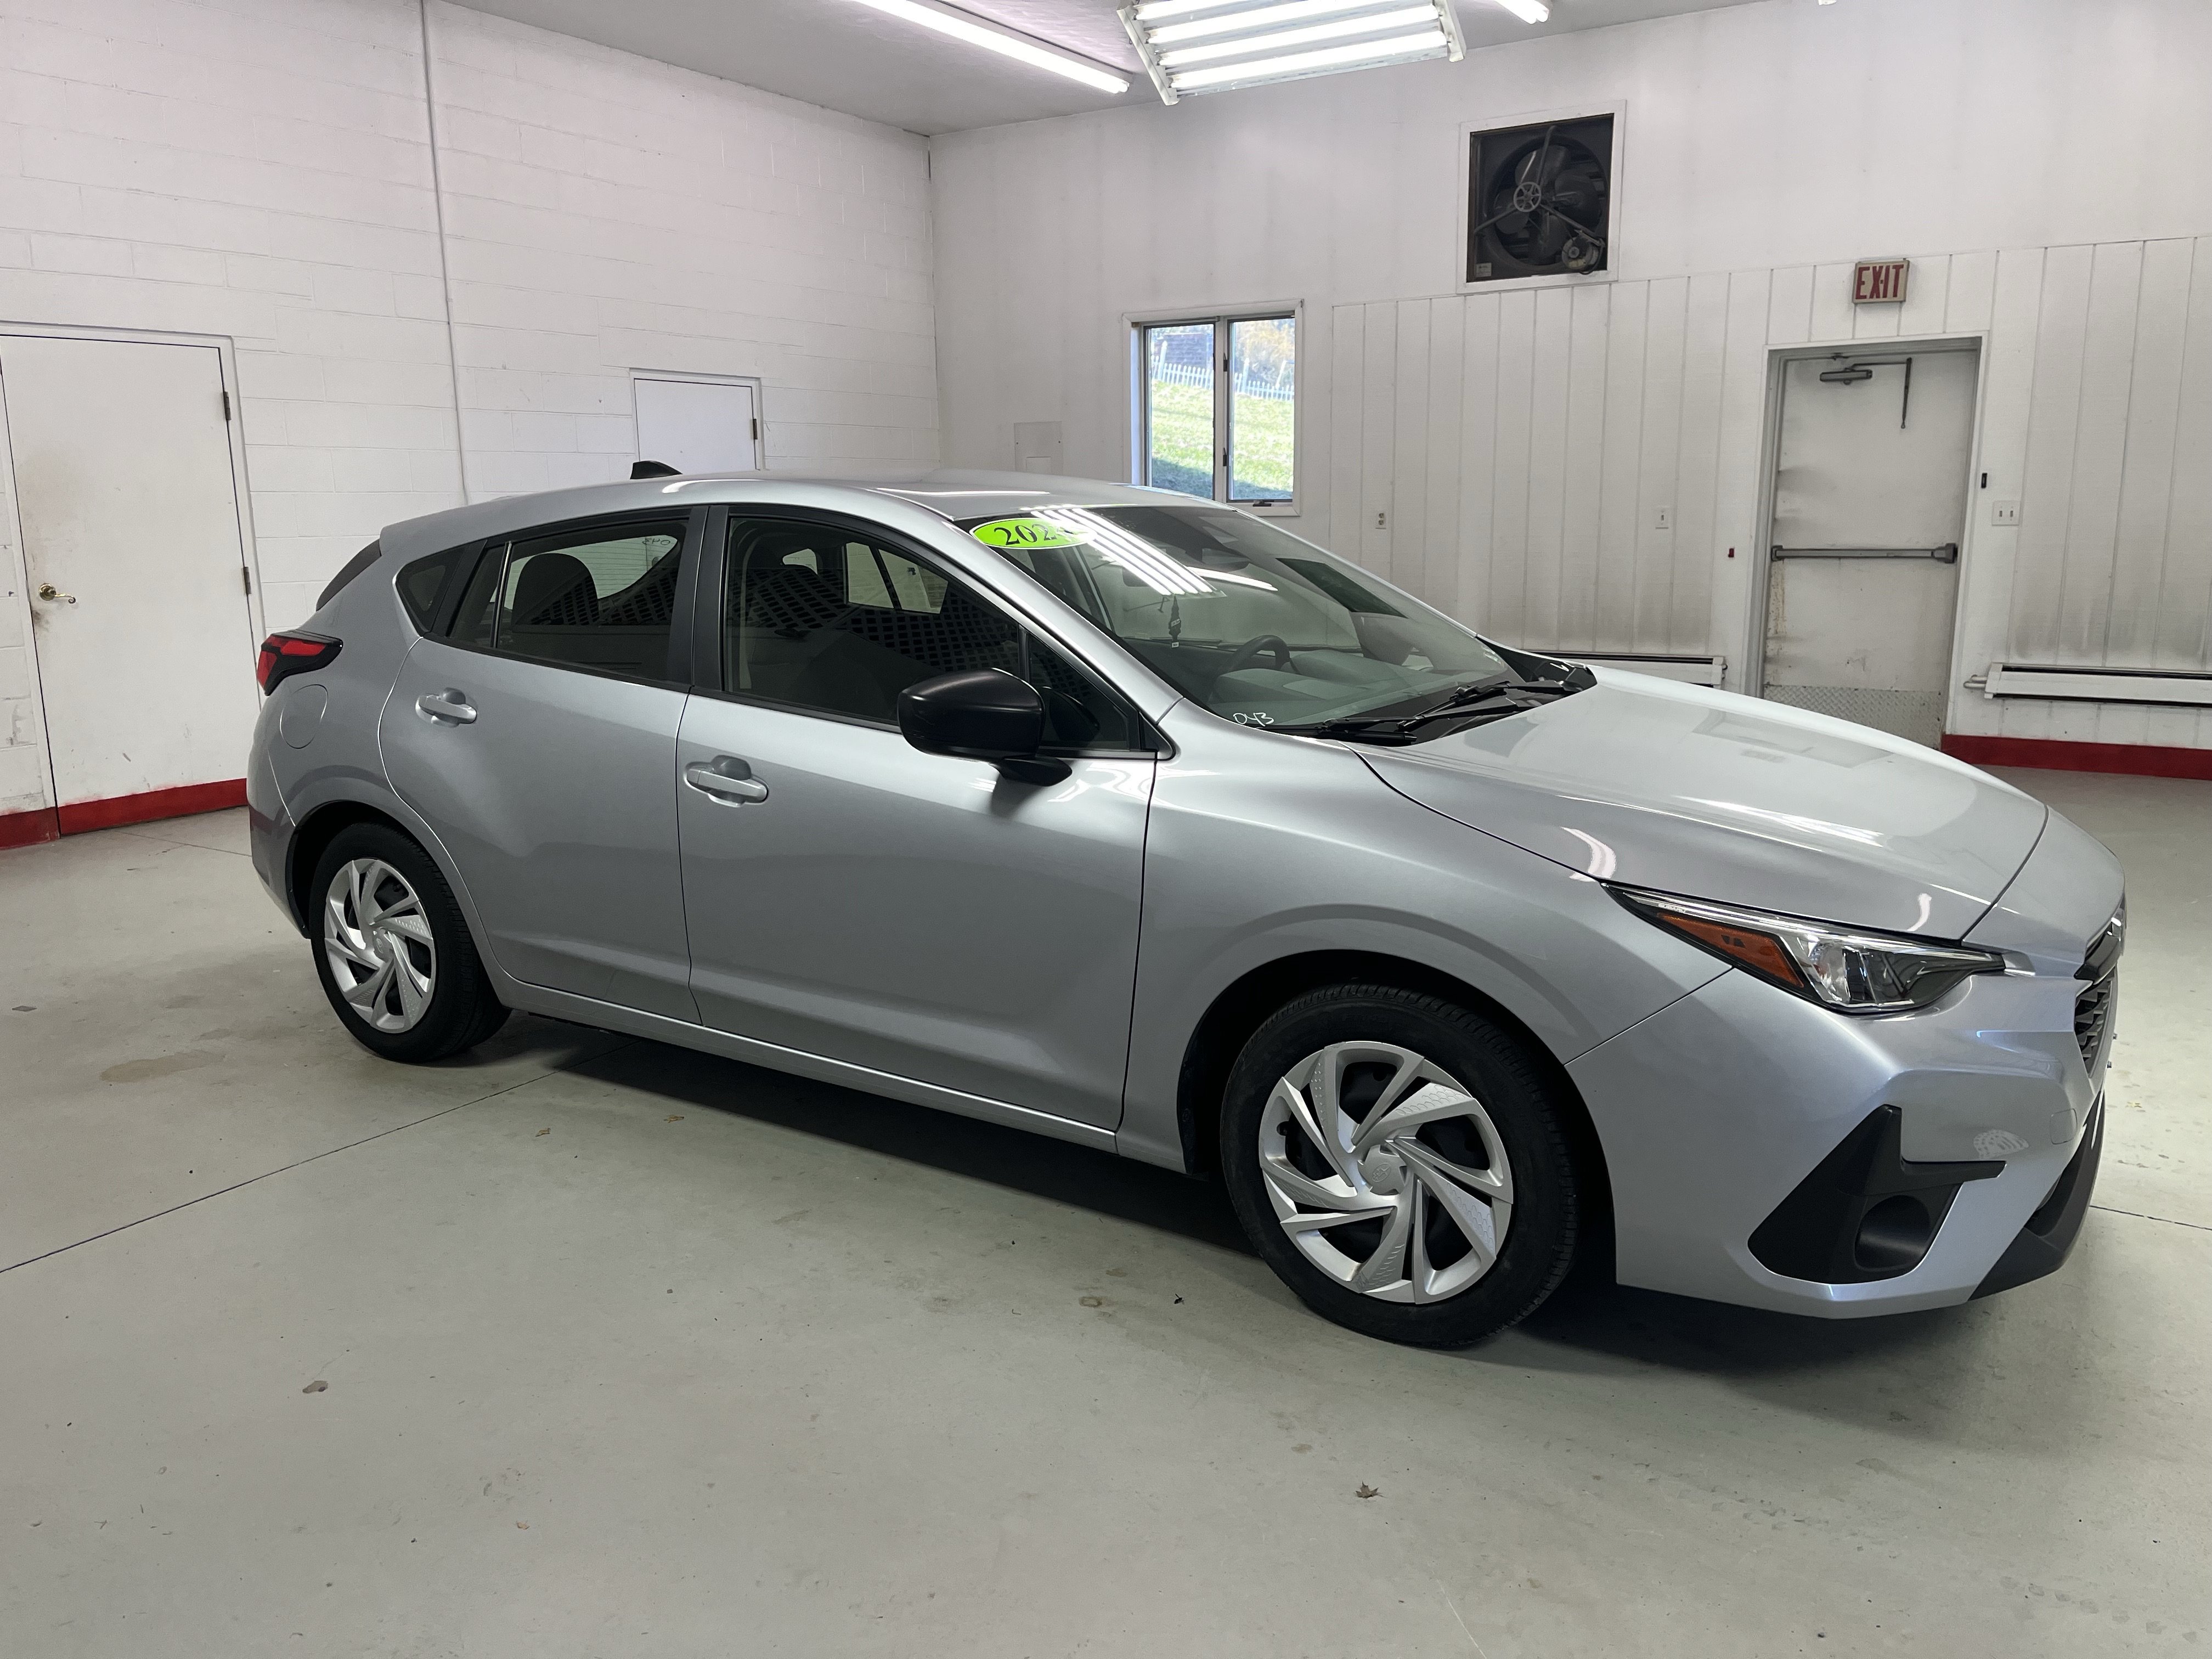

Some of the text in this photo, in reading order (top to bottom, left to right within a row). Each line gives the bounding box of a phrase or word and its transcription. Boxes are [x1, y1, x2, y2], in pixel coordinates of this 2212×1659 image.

[1855, 264, 1904, 299] EXIT
[994, 524, 1076, 545] 202
[1658, 902, 1686, 913] SUBARU
